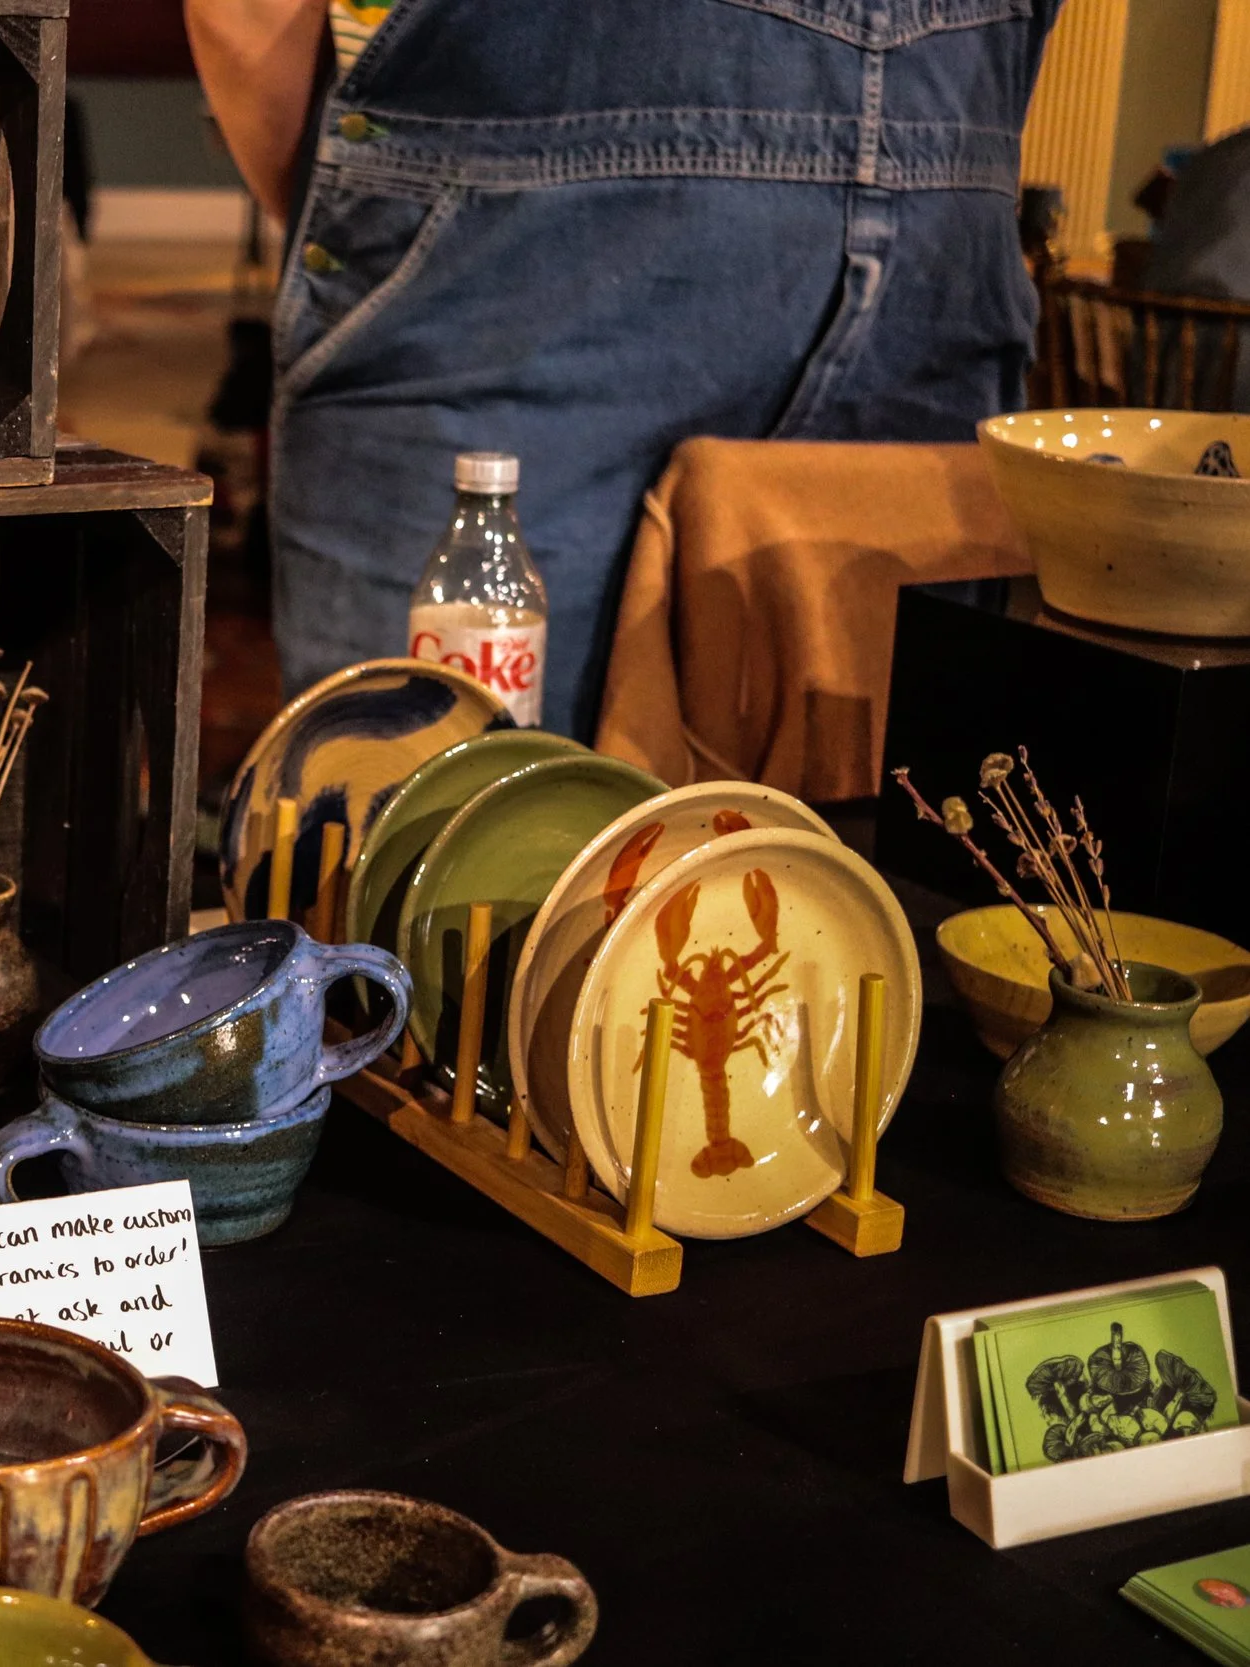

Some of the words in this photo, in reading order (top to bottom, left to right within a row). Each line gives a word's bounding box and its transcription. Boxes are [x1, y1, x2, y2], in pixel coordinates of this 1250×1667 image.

[51, 1214, 114, 1239] make
[123, 1207, 192, 1230] custom
[94, 1256, 115, 1276] to
[125, 1237, 188, 1268] order!
[58, 1298, 103, 1321] ask
[120, 1284, 173, 1311] and
[150, 1331, 173, 1351] or
